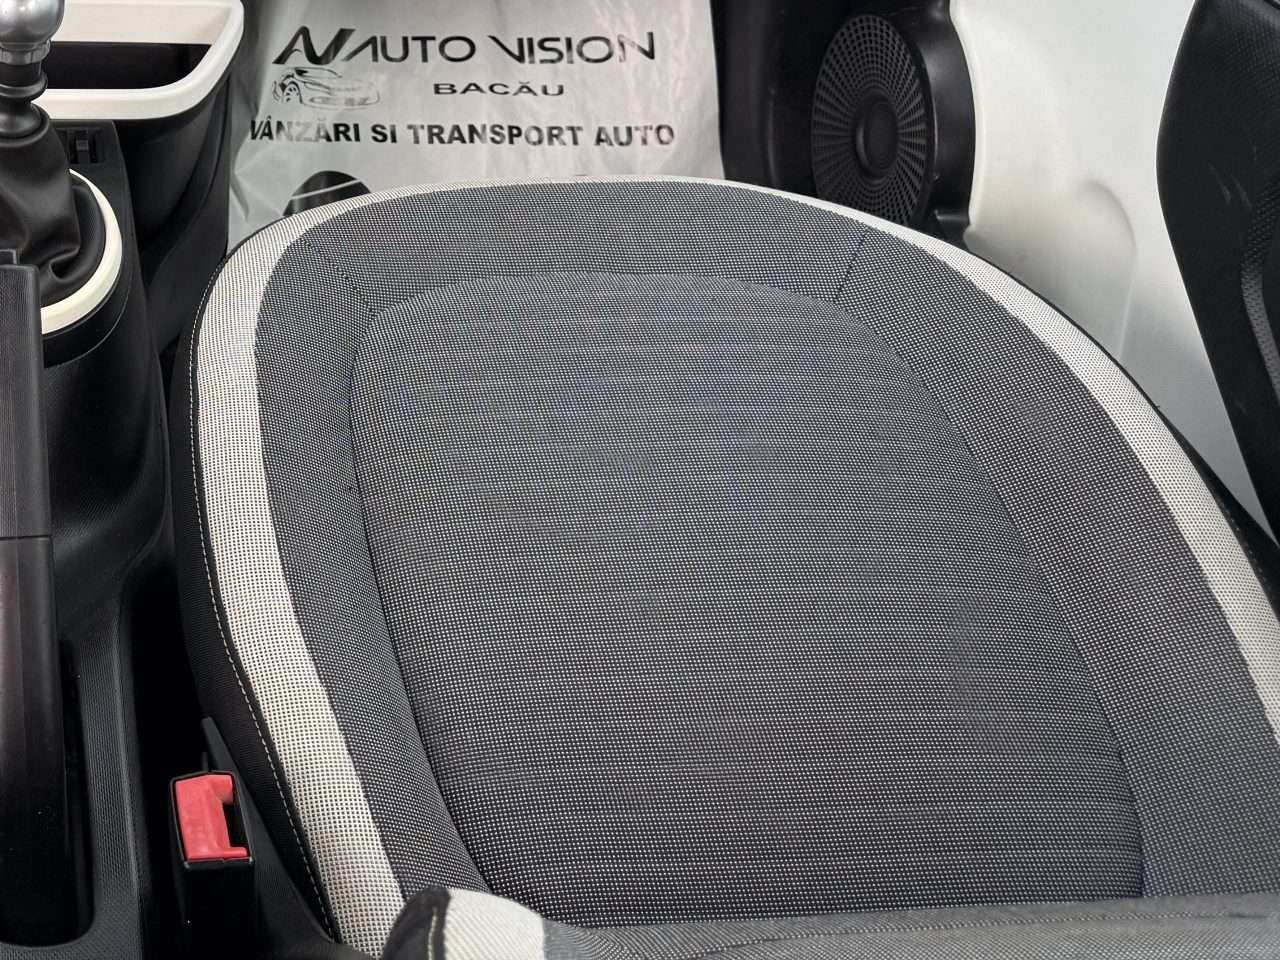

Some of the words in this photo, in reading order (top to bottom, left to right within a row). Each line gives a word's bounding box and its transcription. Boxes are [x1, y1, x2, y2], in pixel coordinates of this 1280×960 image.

[341, 35, 477, 64] AUTO
[488, 31, 656, 65] VISION
[433, 81, 565, 97] BACĂU
[371, 123, 398, 144] SI
[407, 123, 584, 147] TRANSPORT
[594, 123, 675, 147] AUTO
